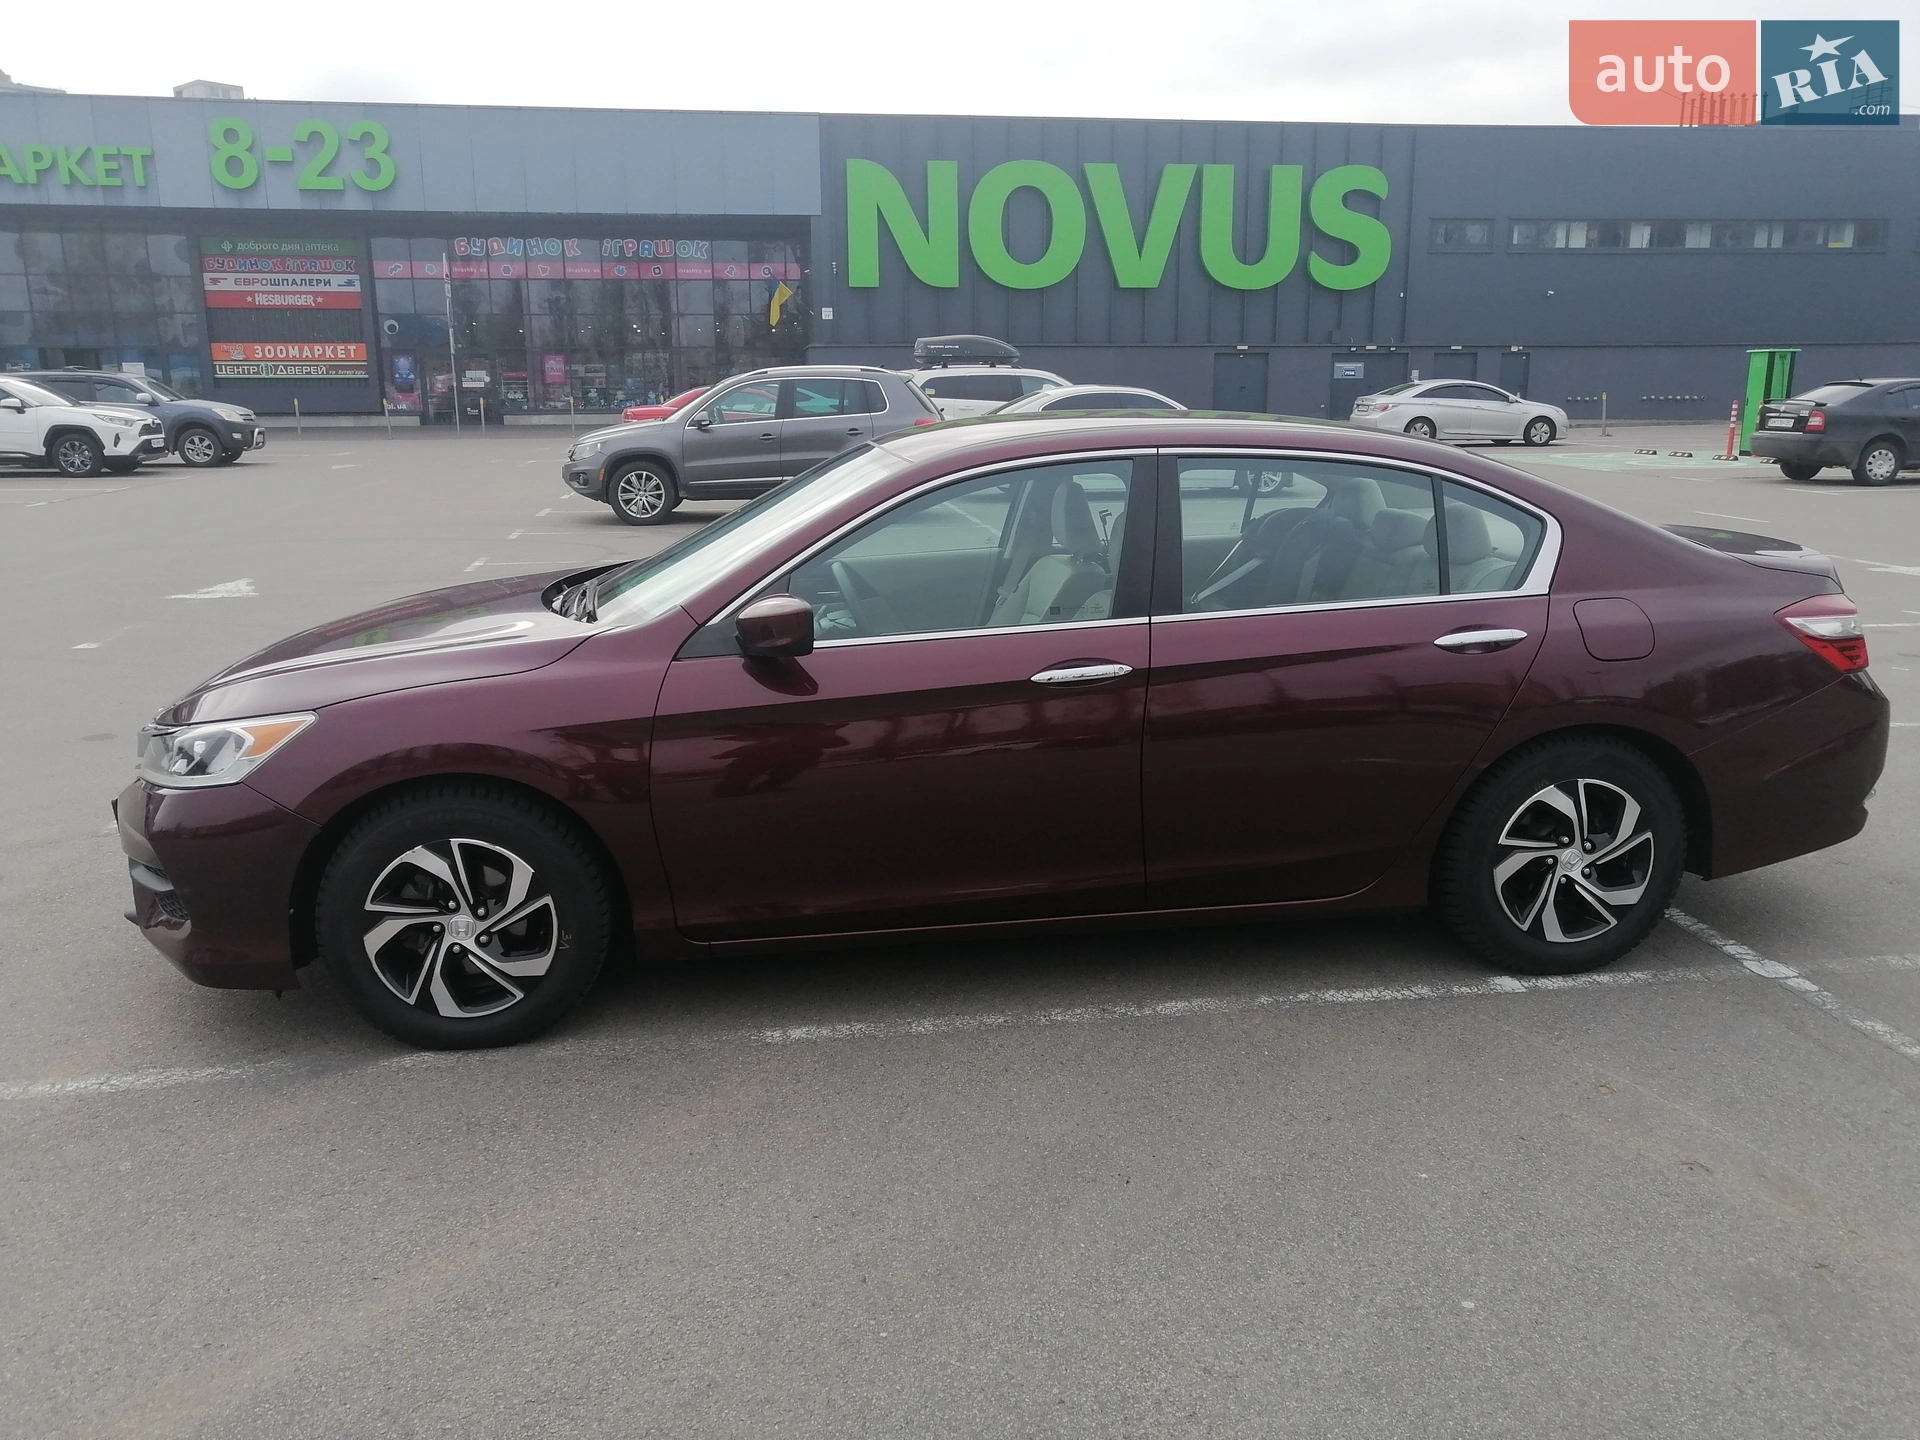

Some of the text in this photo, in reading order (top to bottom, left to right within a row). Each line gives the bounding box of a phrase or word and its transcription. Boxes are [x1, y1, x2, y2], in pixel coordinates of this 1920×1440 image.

[208, 116, 396, 192] 8-23
[846, 158, 1392, 291] NOVUS
[237, 241, 339, 253] доброго дня аптека
[454, 237, 582, 257] БУДИНОК
[205, 257, 282, 272] БУДИНОК
[234, 277, 332, 287] ЄВРОШПАЛЕРИ
[253, 345, 357, 358] ЗООМАРКЕТ
